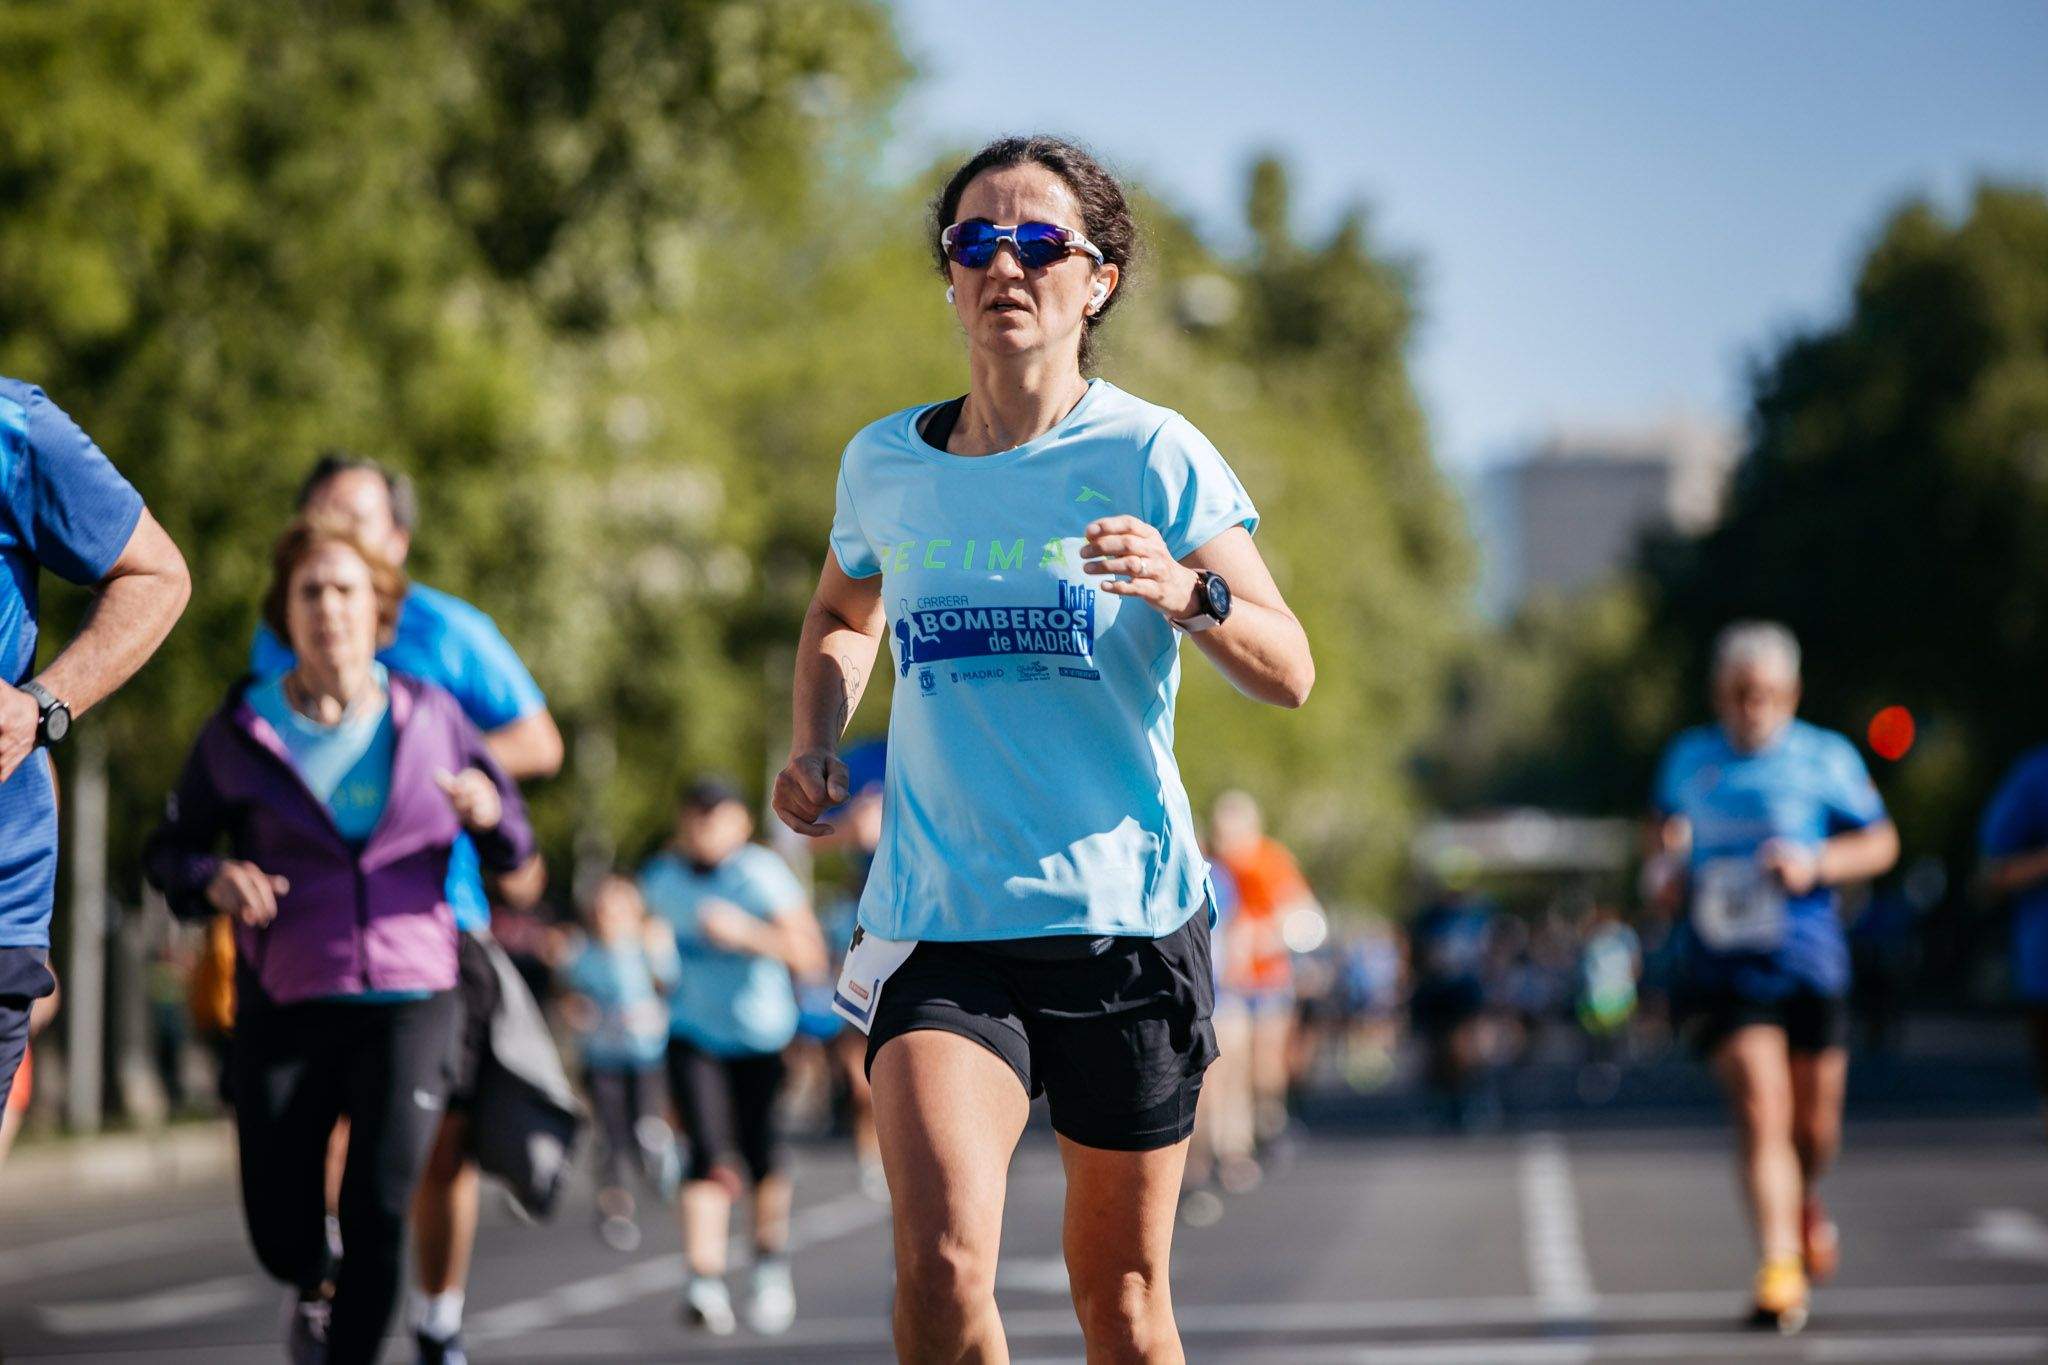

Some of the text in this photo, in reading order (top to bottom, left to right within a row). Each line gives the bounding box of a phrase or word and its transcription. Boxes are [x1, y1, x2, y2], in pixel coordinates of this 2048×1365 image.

[881, 537, 1092, 576] ECIMA
[917, 595, 969, 609] CARRERA
[920, 609, 1088, 633] BOMBEROS
[988, 630, 1011, 652] de
[962, 668, 1004, 681] MADRID
